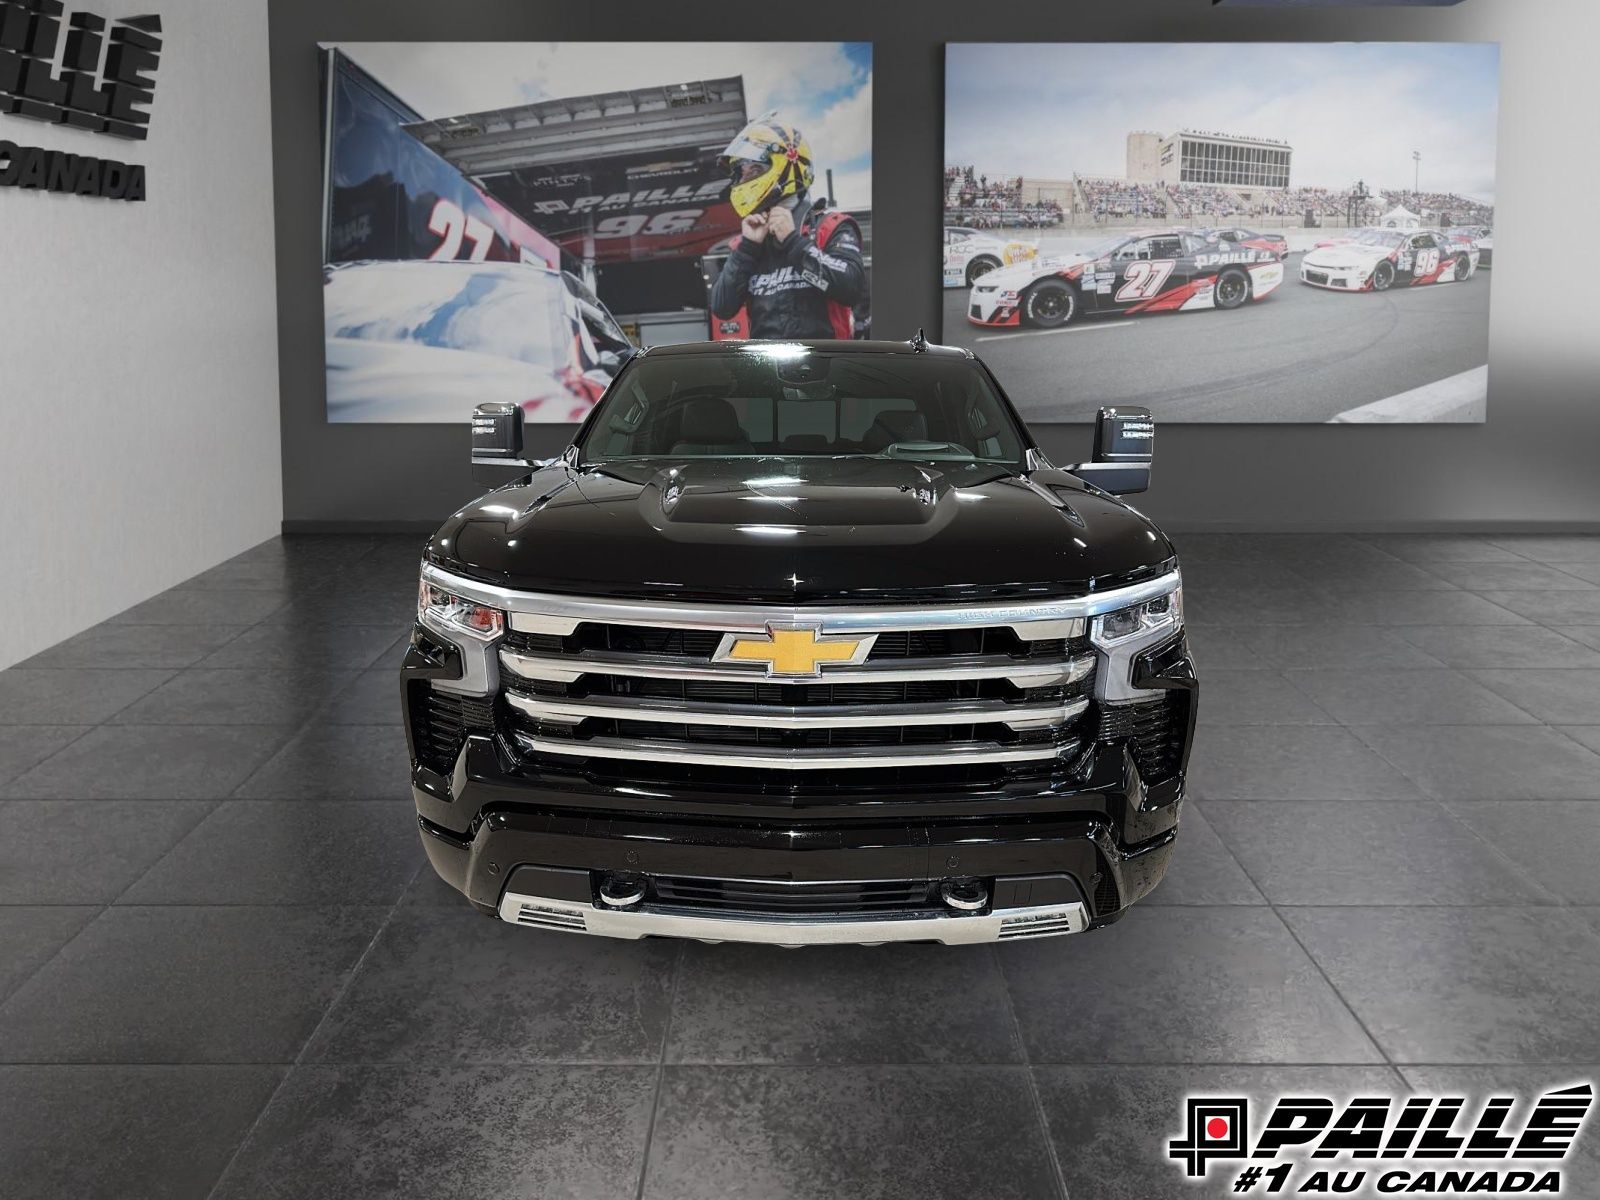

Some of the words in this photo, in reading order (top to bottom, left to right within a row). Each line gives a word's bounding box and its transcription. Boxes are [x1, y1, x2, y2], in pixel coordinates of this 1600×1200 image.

[627, 168, 698, 180] CHEVROLET
[633, 195, 719, 208] CANADA
[428, 198, 495, 262] 27
[594, 209, 704, 240] 96
[1414, 247, 1440, 277] 96
[1115, 259, 1176, 302] 27
